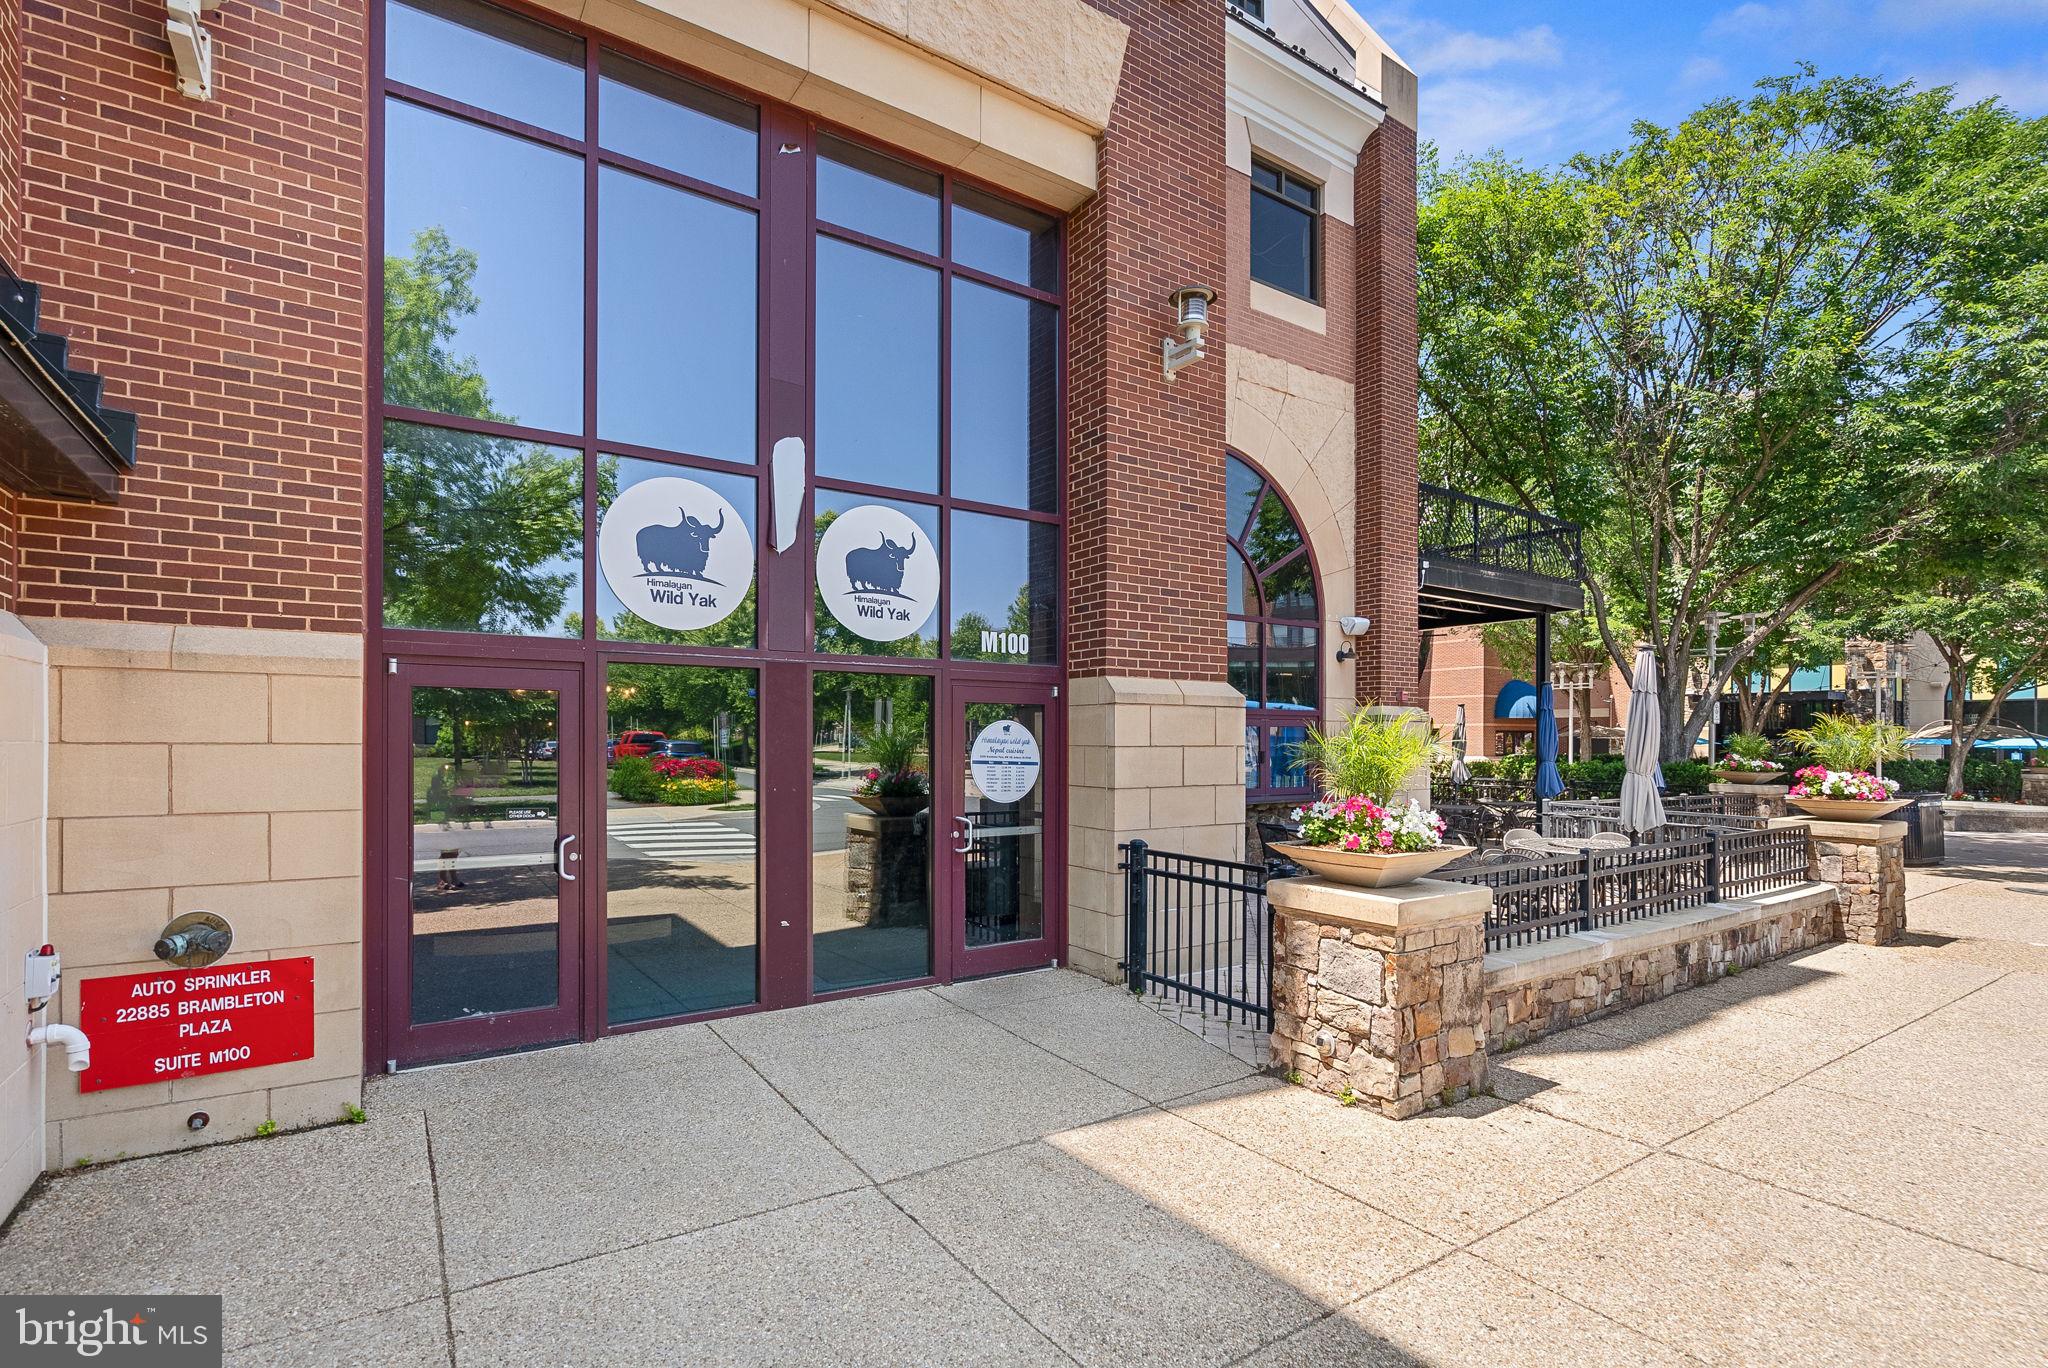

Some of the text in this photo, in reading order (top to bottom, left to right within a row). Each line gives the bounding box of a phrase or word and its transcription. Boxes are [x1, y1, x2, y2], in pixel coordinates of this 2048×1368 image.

[646, 578, 692, 591] Himalayan
[650, 588, 717, 608] Wild Yak
[854, 595, 891, 607] Himalayan
[857, 604, 911, 621] Wild Yak
[981, 630, 1029, 655] M100
[131, 969, 271, 998] AUTO SPRINKLER
[116, 990, 285, 1023] 22885 BRAMBLETON
[179, 1019, 232, 1038] PLAZA
[154, 1046, 251, 1073] SUITE M100
